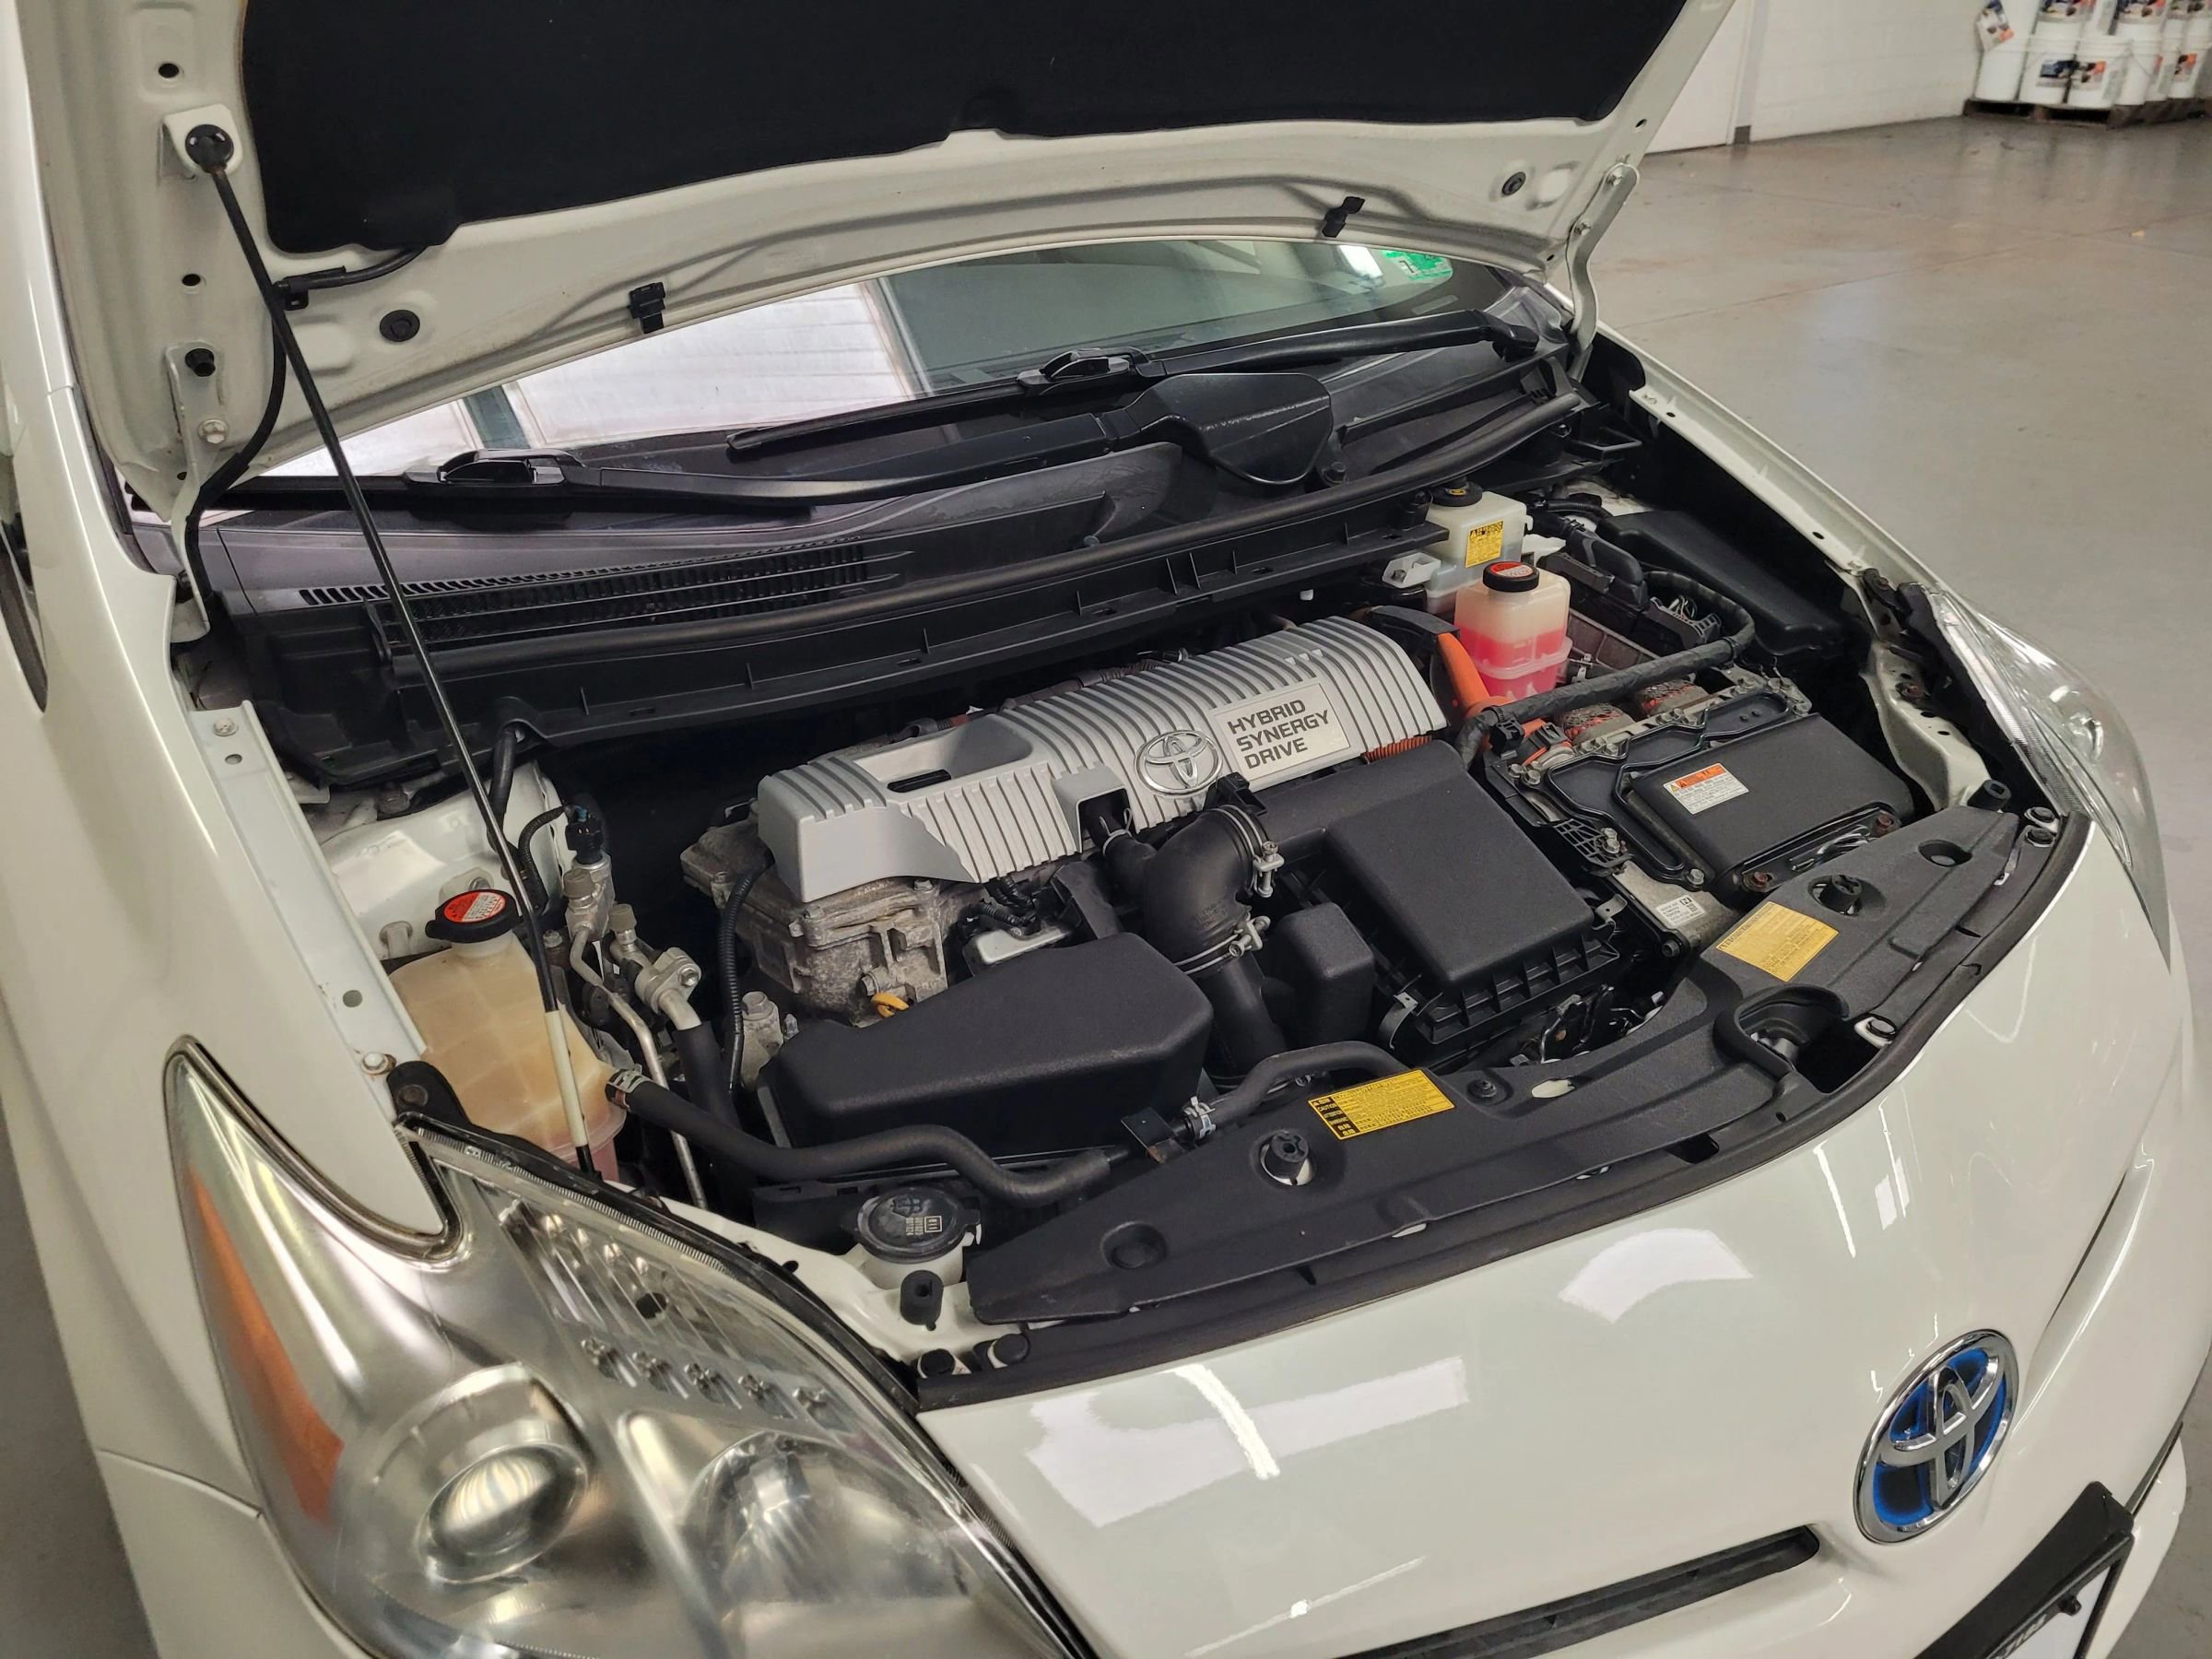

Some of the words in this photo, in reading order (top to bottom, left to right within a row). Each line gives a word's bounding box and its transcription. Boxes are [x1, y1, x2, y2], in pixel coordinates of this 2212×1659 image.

[1227, 699, 1306, 735] HYBRID
[1236, 710, 1329, 752] SYNERGY
[1244, 737, 1308, 770] DRIVE
